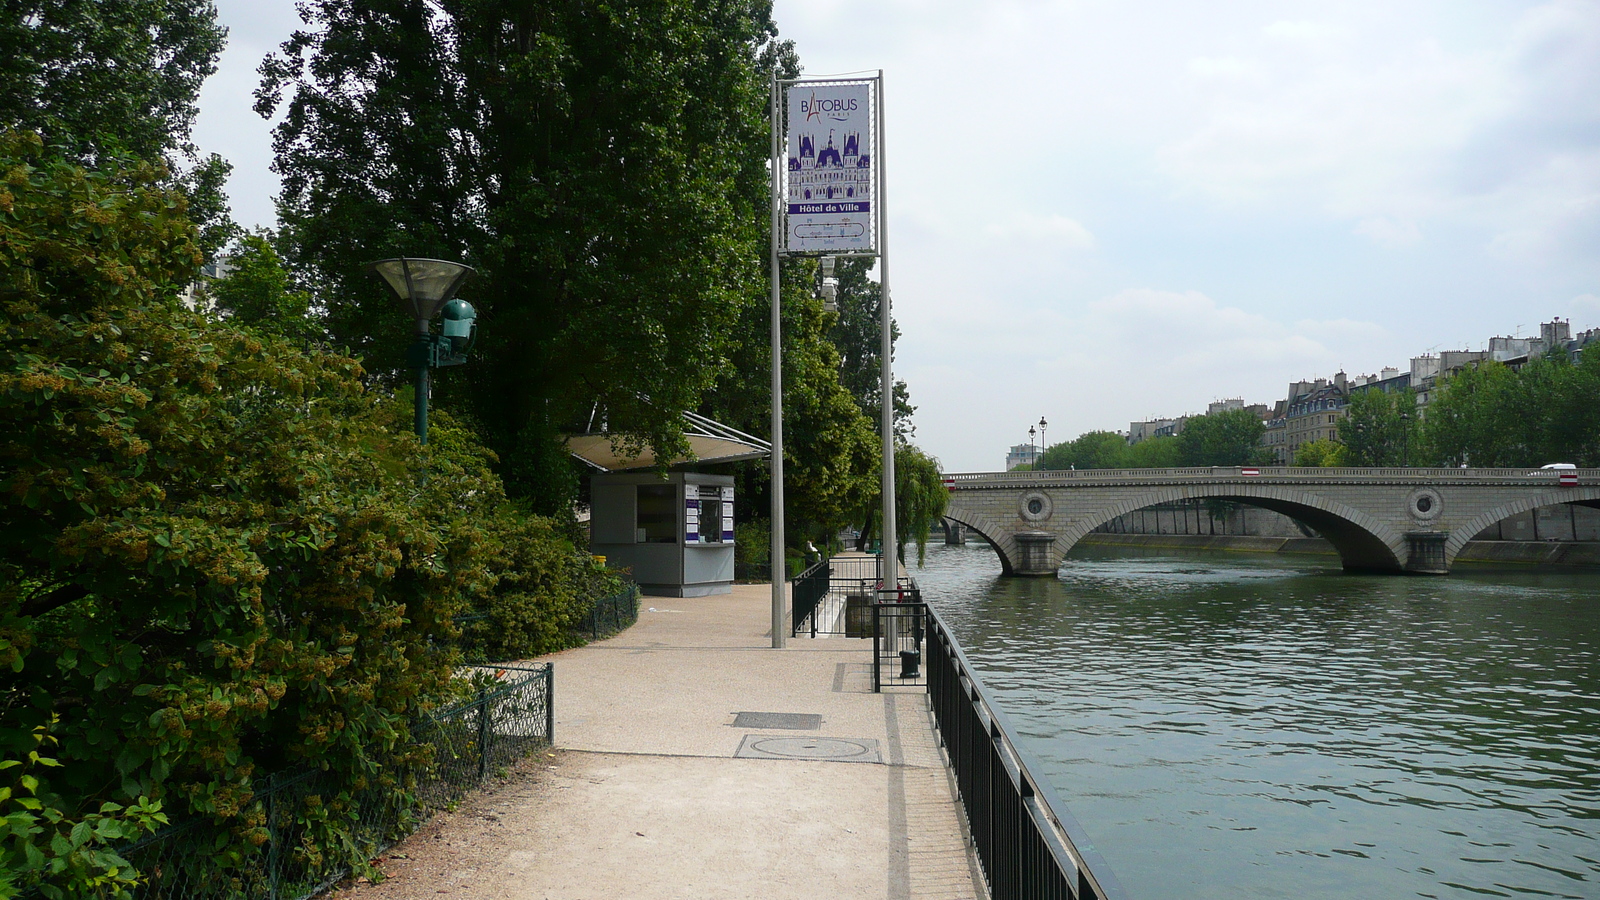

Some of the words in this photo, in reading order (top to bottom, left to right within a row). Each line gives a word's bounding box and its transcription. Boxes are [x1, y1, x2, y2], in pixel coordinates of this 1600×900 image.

[801, 90, 858, 124] BATOBUS
[799, 204, 823, 213] Hôtel
[825, 204, 837, 212] de
[839, 203, 859, 211] Ville
